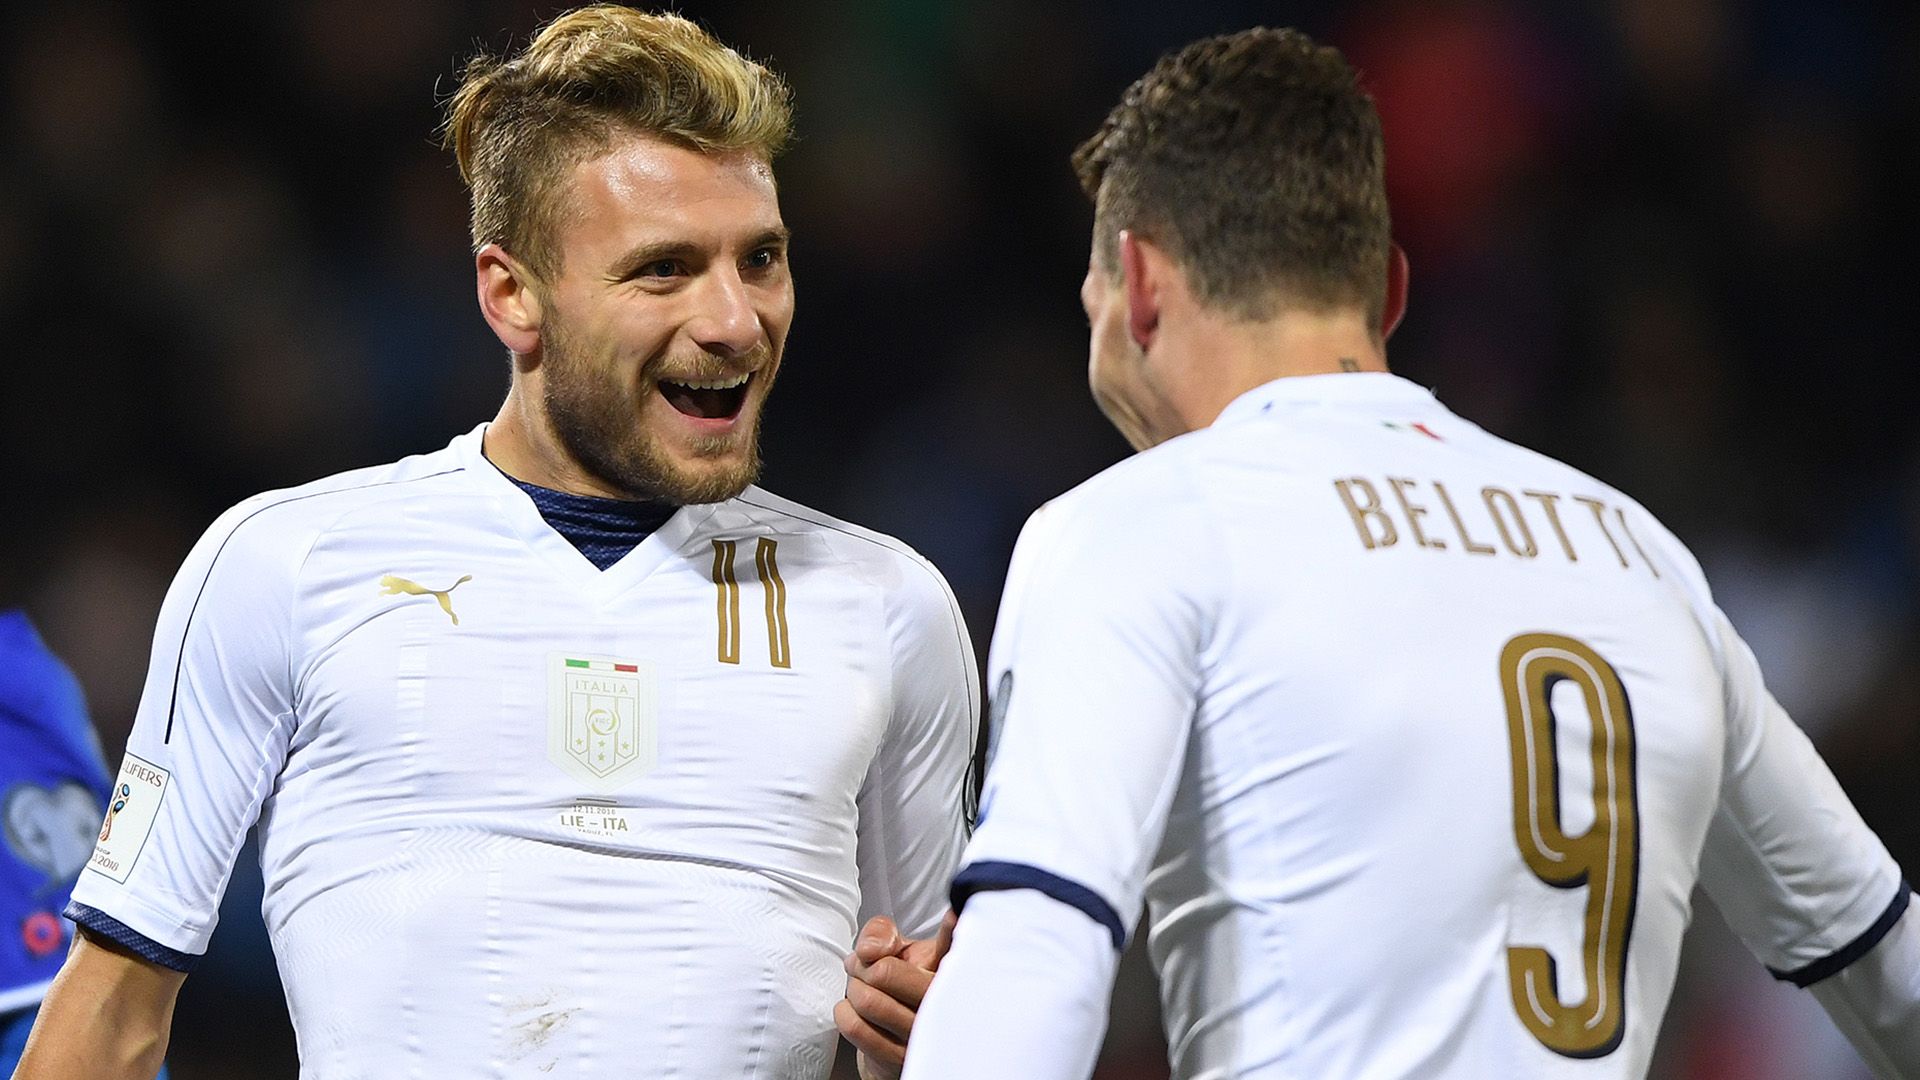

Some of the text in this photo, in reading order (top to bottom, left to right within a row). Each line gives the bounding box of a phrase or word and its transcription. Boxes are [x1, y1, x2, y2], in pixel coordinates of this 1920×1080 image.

[1333, 476, 1660, 580] BELOTTI
[711, 536, 792, 669] 11
[575, 679, 629, 695] ITALIA
[560, 815, 585, 828] LIE
[603, 817, 629, 832] ITA
[1499, 632, 1640, 1059] 9
